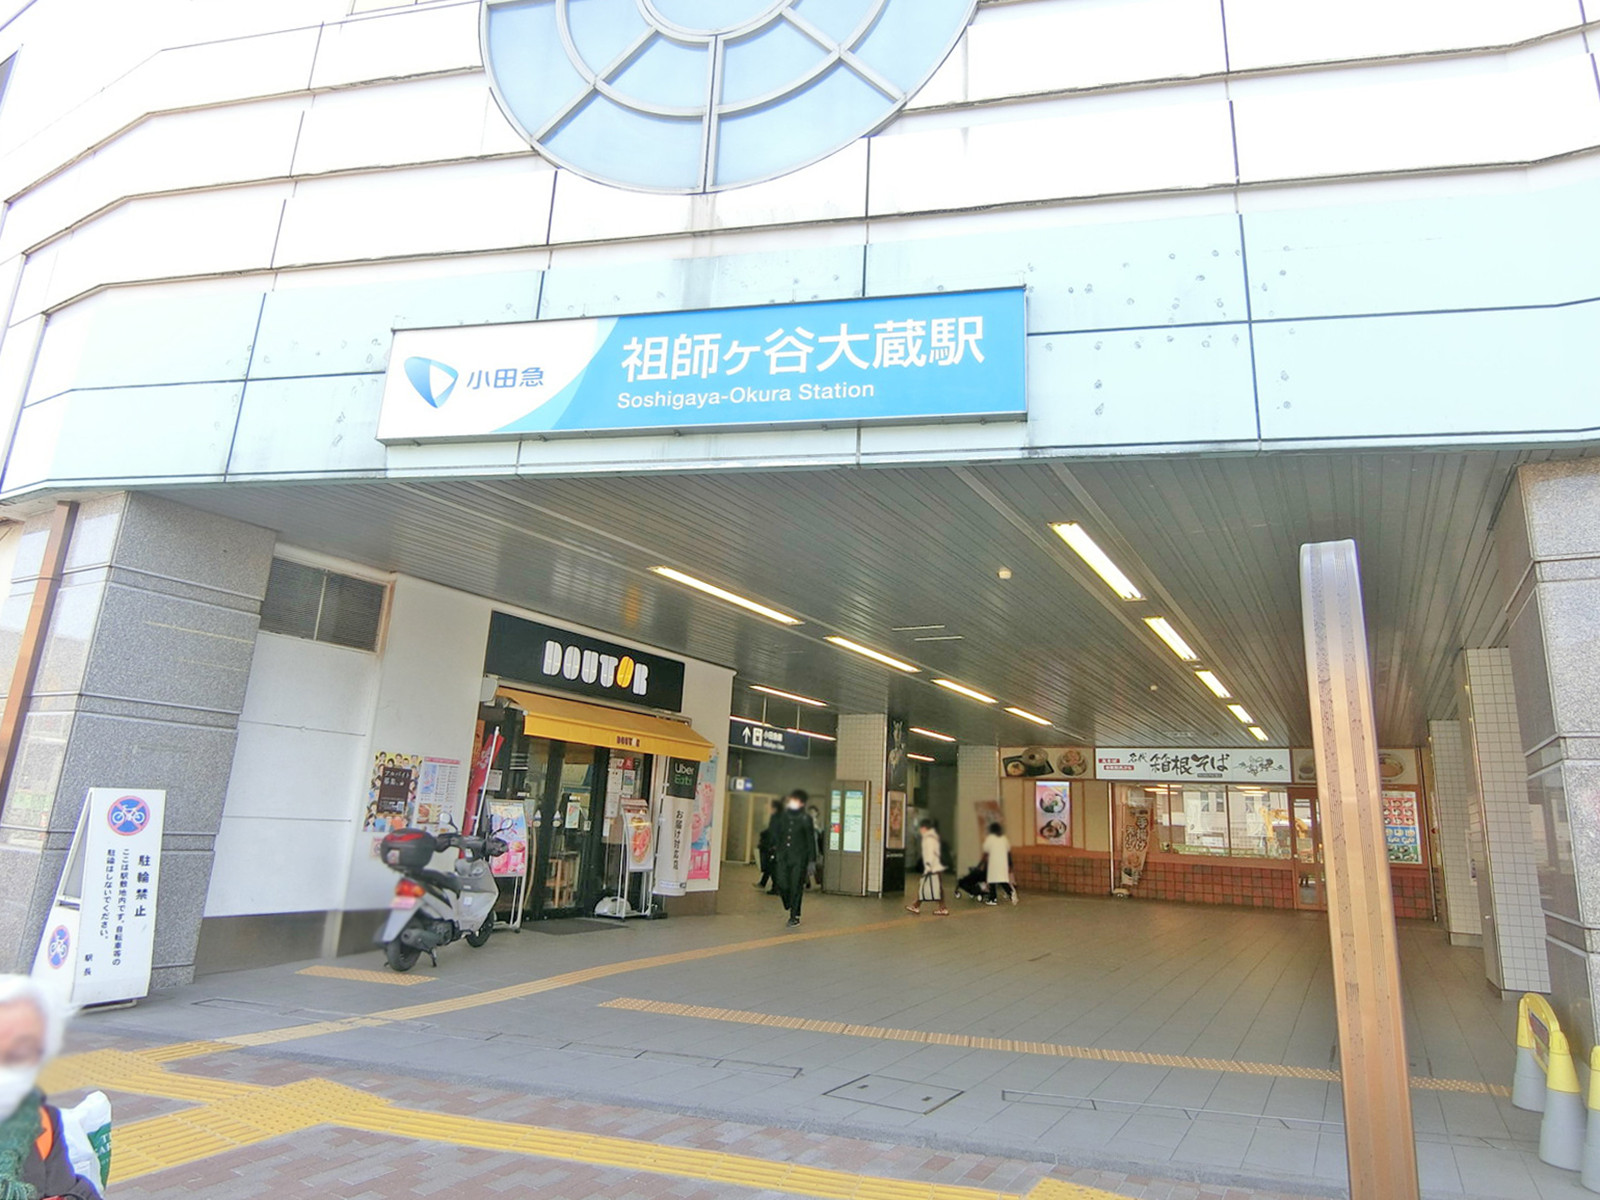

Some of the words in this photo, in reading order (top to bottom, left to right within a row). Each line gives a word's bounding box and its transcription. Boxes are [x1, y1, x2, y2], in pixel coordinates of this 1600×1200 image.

[466, 365, 544, 389] 小田急
[616, 386, 792, 410] Soshigaya-Okura
[799, 382, 875, 401] Station
[542, 639, 650, 696] DOUTOR
[674, 762, 695, 775] Uber
[1149, 753, 1230, 775] 箱根そば
[674, 774, 693, 786] Eats
[134, 855, 151, 917] 駐輪禁止
